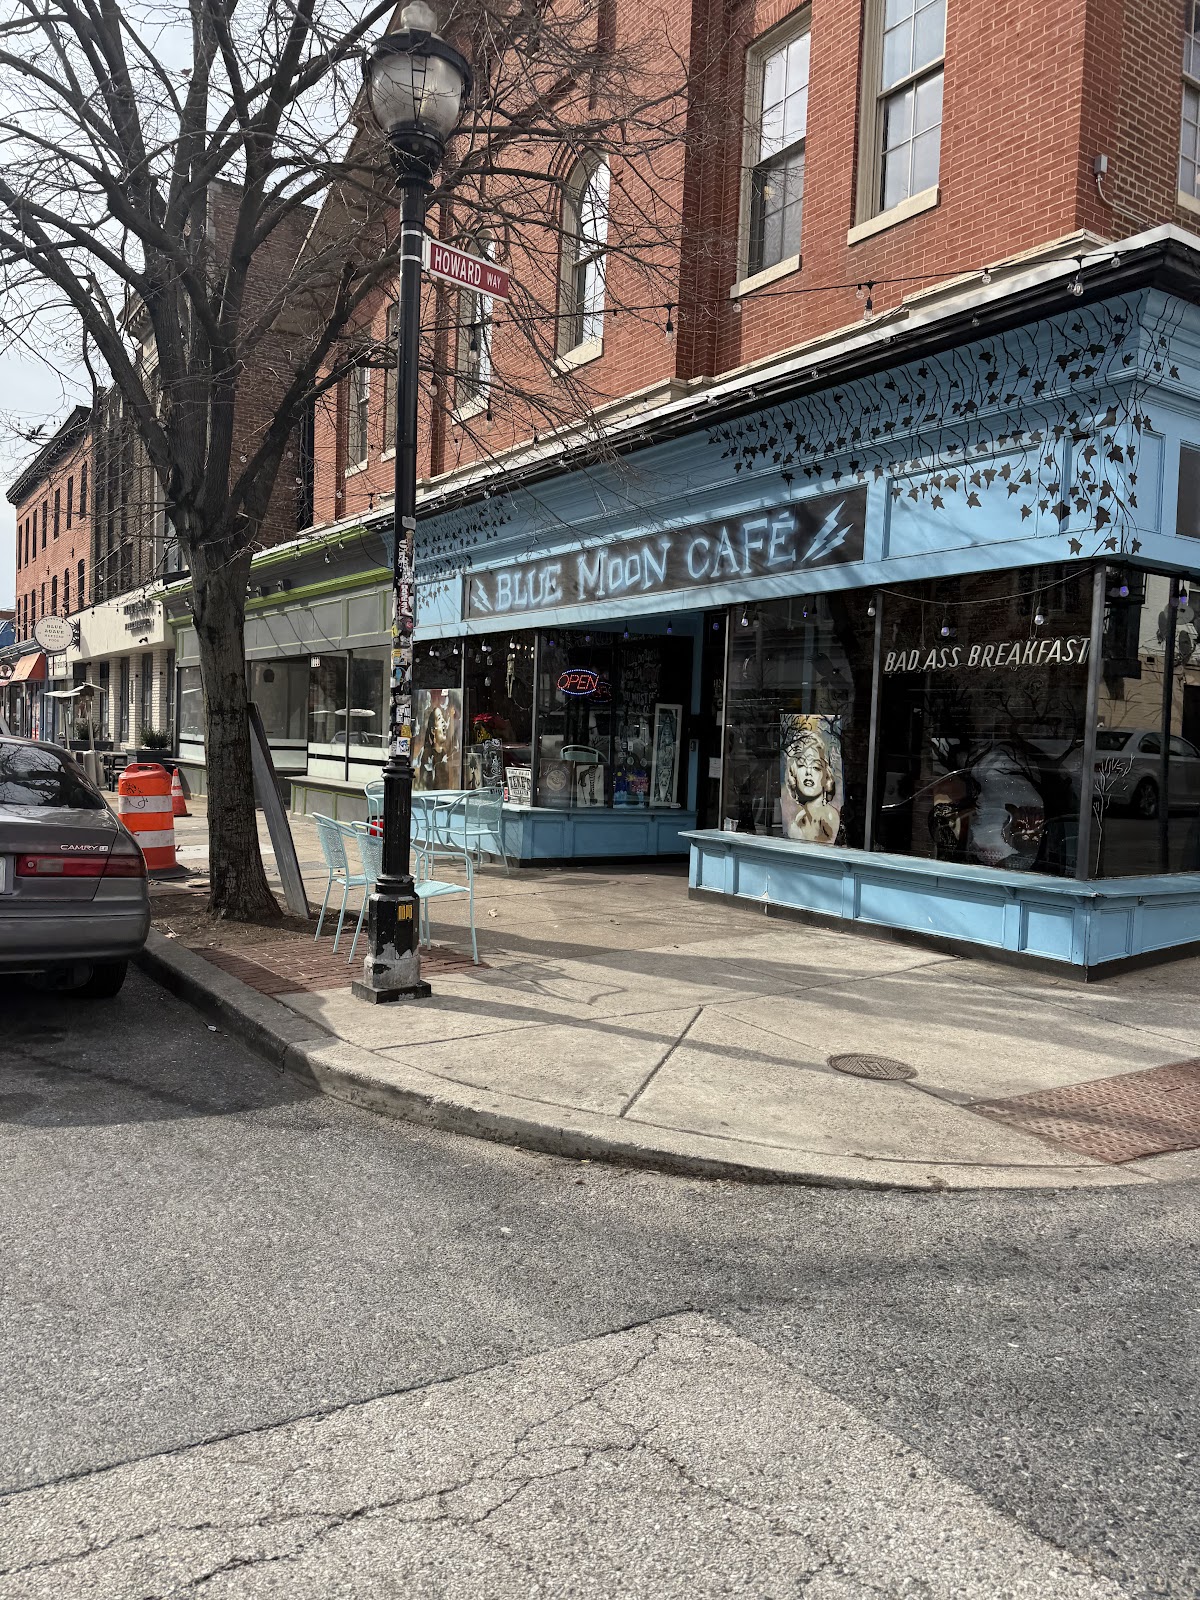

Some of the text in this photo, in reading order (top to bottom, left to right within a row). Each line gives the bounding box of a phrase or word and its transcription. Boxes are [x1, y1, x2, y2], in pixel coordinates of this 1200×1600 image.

[435, 248, 502, 289] HOWARD WAY
[495, 511, 797, 613] BLUE MOON CAFÉ
[884, 637, 1091, 672] BAD ASS BREAKFAST
[557, 674, 600, 690] OPEN
